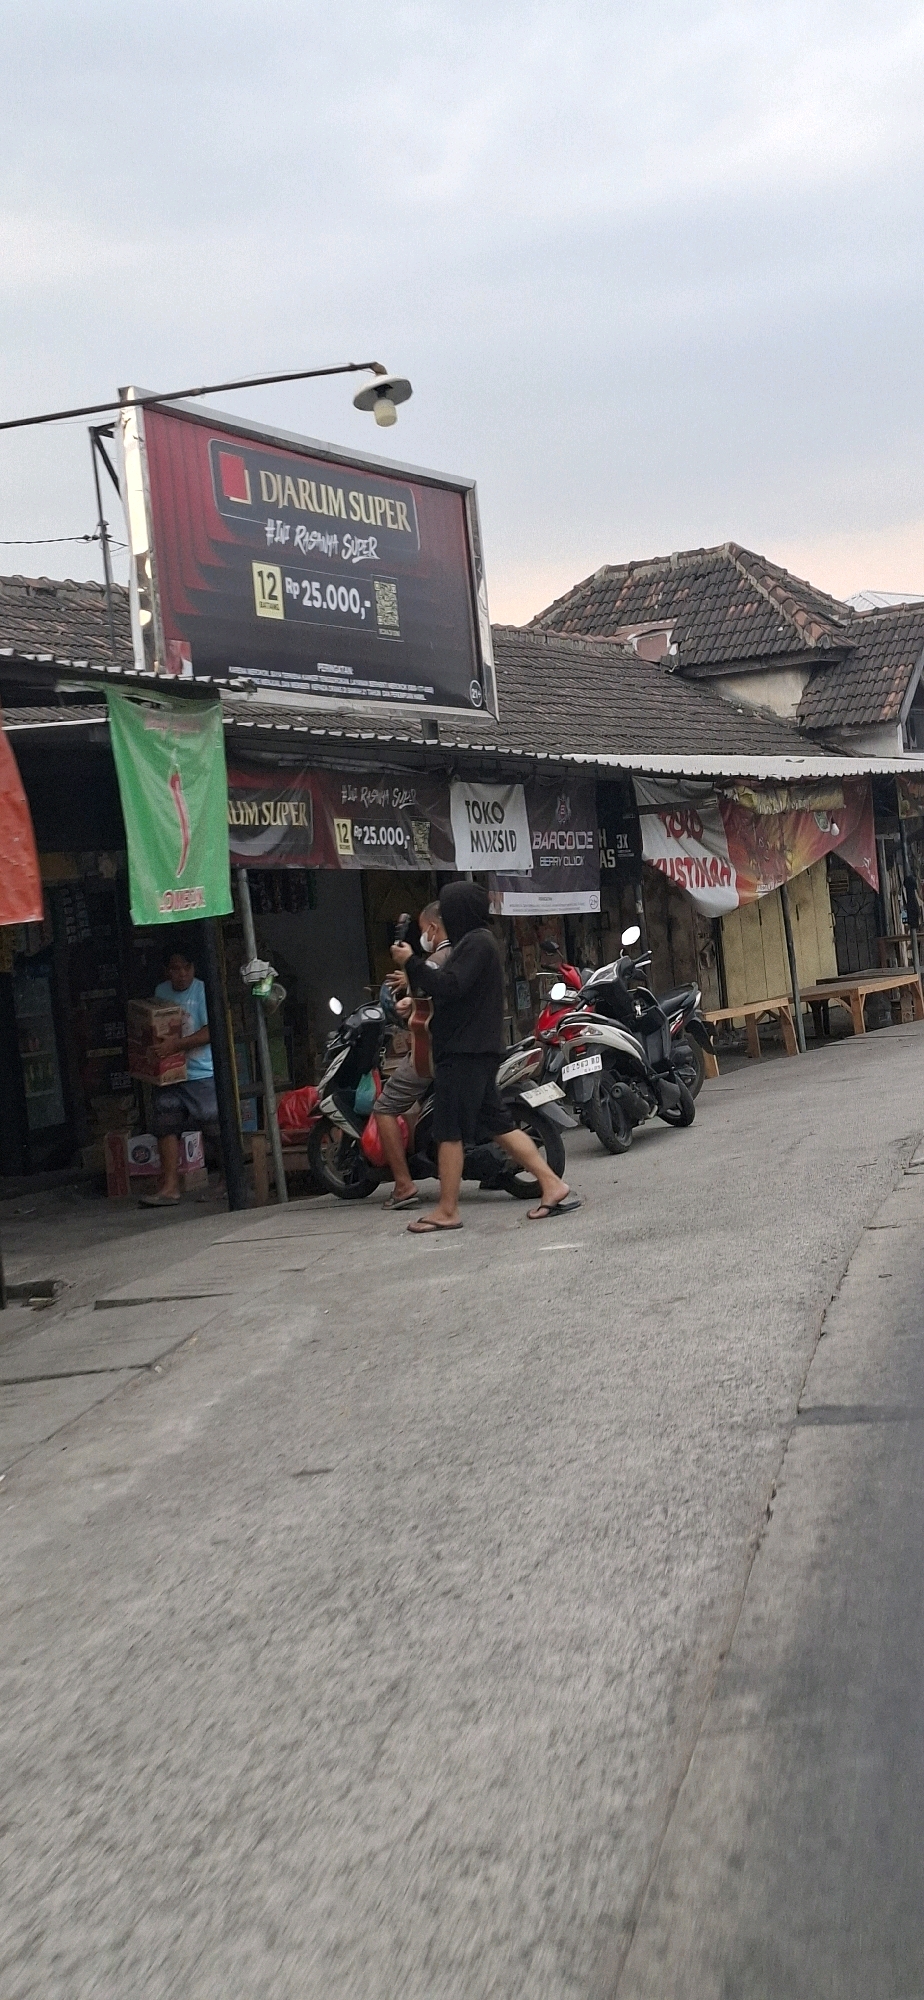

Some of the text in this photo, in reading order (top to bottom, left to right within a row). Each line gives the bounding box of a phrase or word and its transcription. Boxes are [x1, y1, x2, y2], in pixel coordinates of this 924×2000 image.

[260, 470, 412, 532] DJARUM SUPER
[341, 533, 381, 564] SUPER
[257, 570, 278, 601] 12
[285, 577, 300, 599] Rp
[261, 801, 308, 826] SUPER
[465, 800, 505, 825] TOKO
[336, 823, 349, 843] 12
[532, 831, 594, 850] BARCODE
